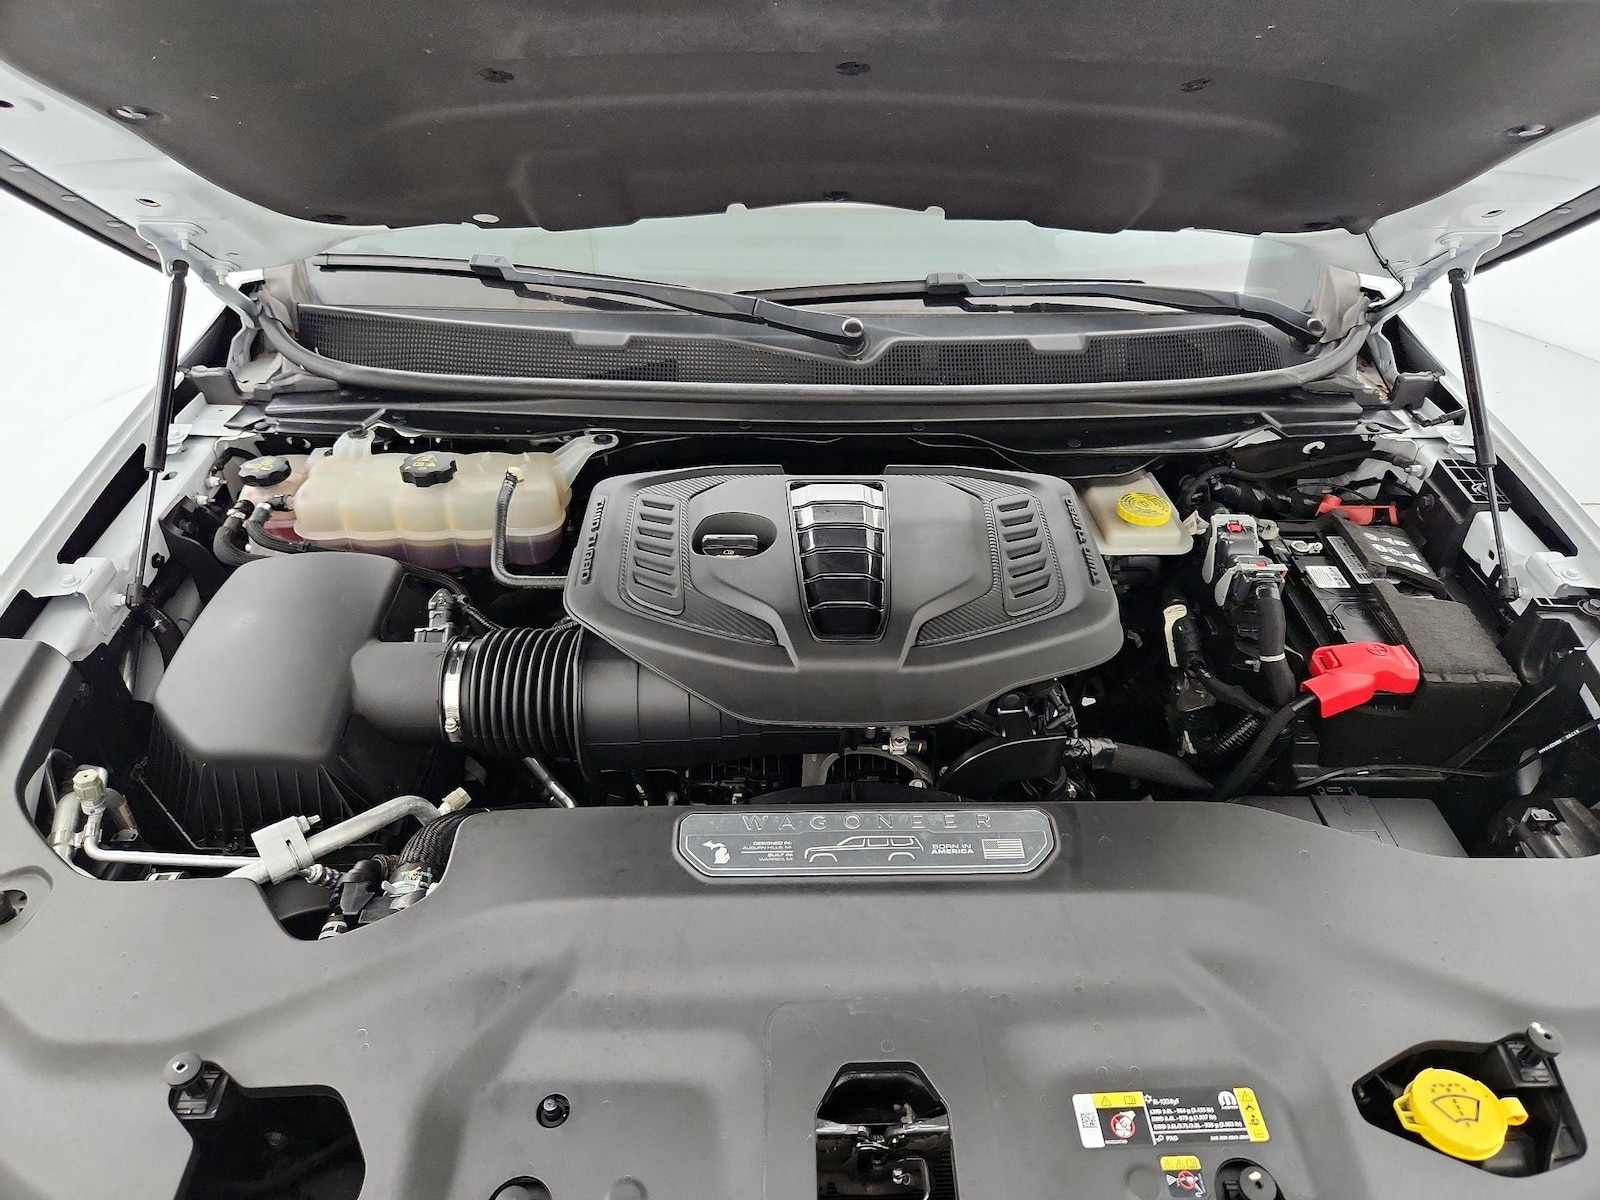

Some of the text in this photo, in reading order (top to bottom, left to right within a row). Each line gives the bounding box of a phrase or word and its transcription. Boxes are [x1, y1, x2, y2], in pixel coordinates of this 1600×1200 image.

[1064, 497, 1087, 545] TURBO
[581, 532, 599, 583] TURBO
[742, 812, 991, 831] WAGONEER
